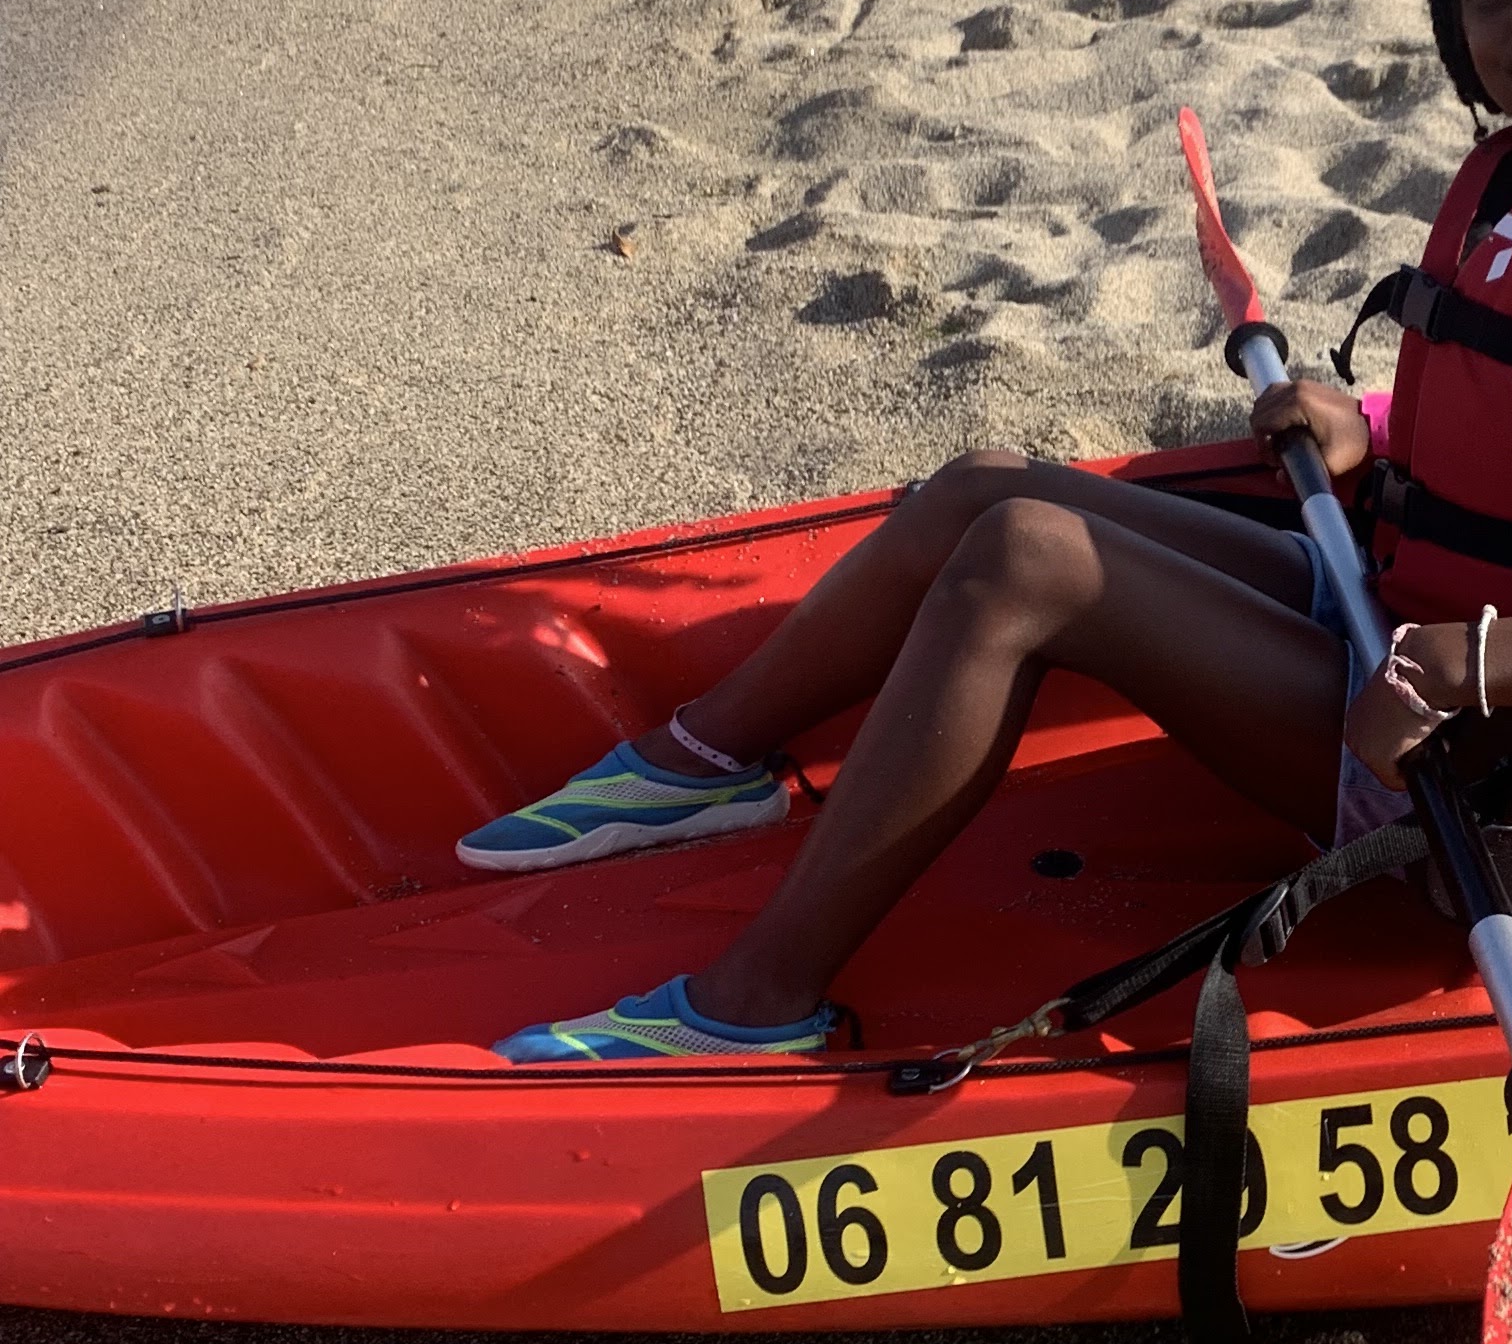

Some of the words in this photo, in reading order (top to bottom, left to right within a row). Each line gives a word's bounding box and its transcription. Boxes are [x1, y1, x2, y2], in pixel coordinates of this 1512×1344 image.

[739, 1164, 888, 1295] 06
[931, 1140, 1067, 1272] 81
[1318, 1096, 1458, 1225] 58
